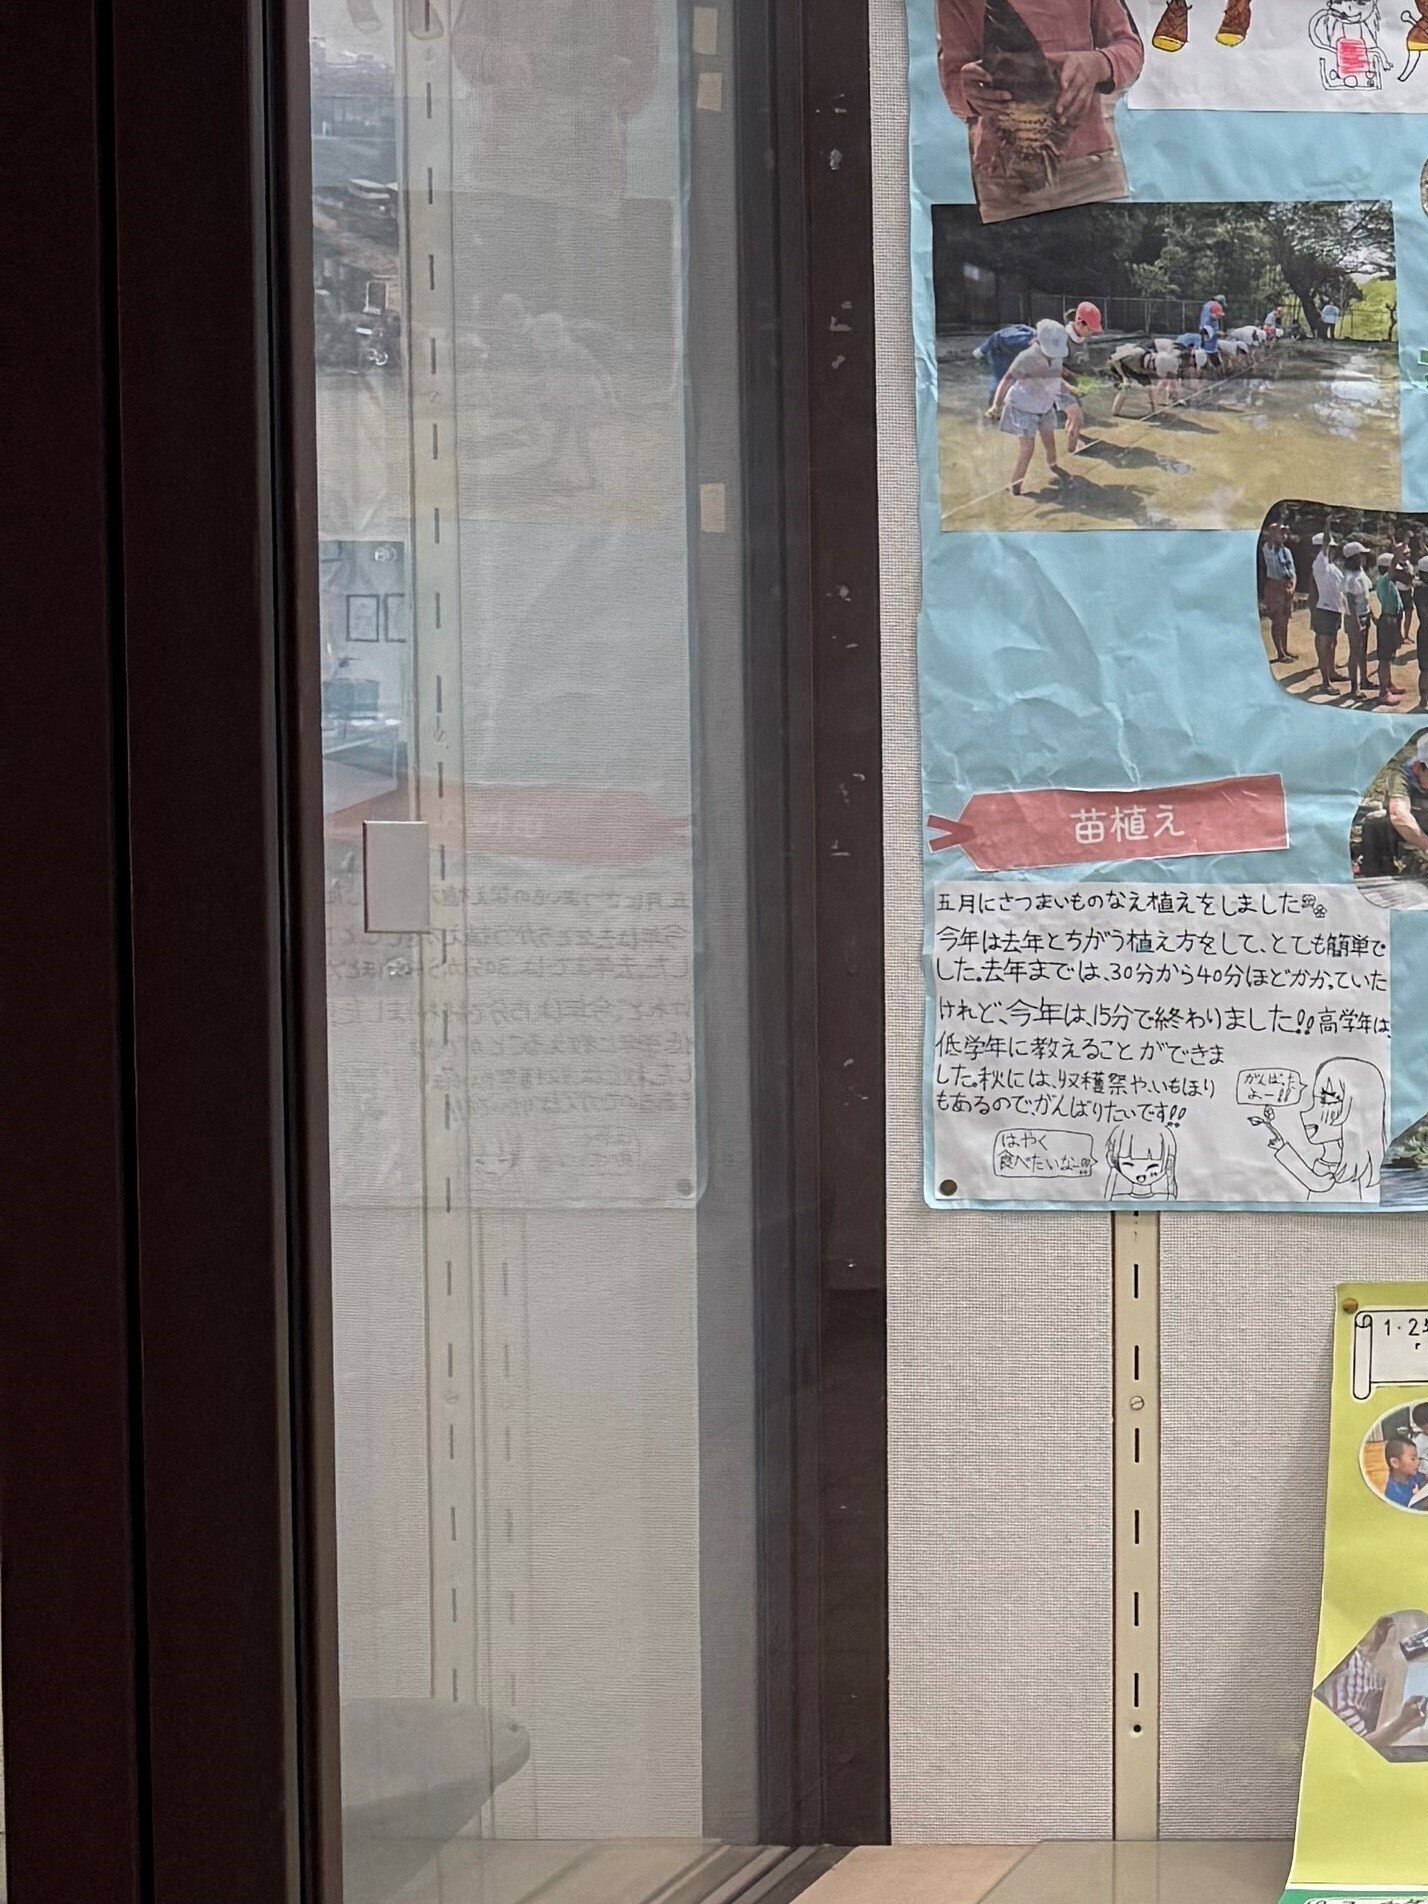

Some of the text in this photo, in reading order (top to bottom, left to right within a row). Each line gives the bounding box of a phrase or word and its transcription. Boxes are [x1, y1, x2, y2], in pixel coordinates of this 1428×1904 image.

[1070, 805, 1186, 846] 苗植え
[935, 1034, 1226, 1066] 低学年に教えることができま
